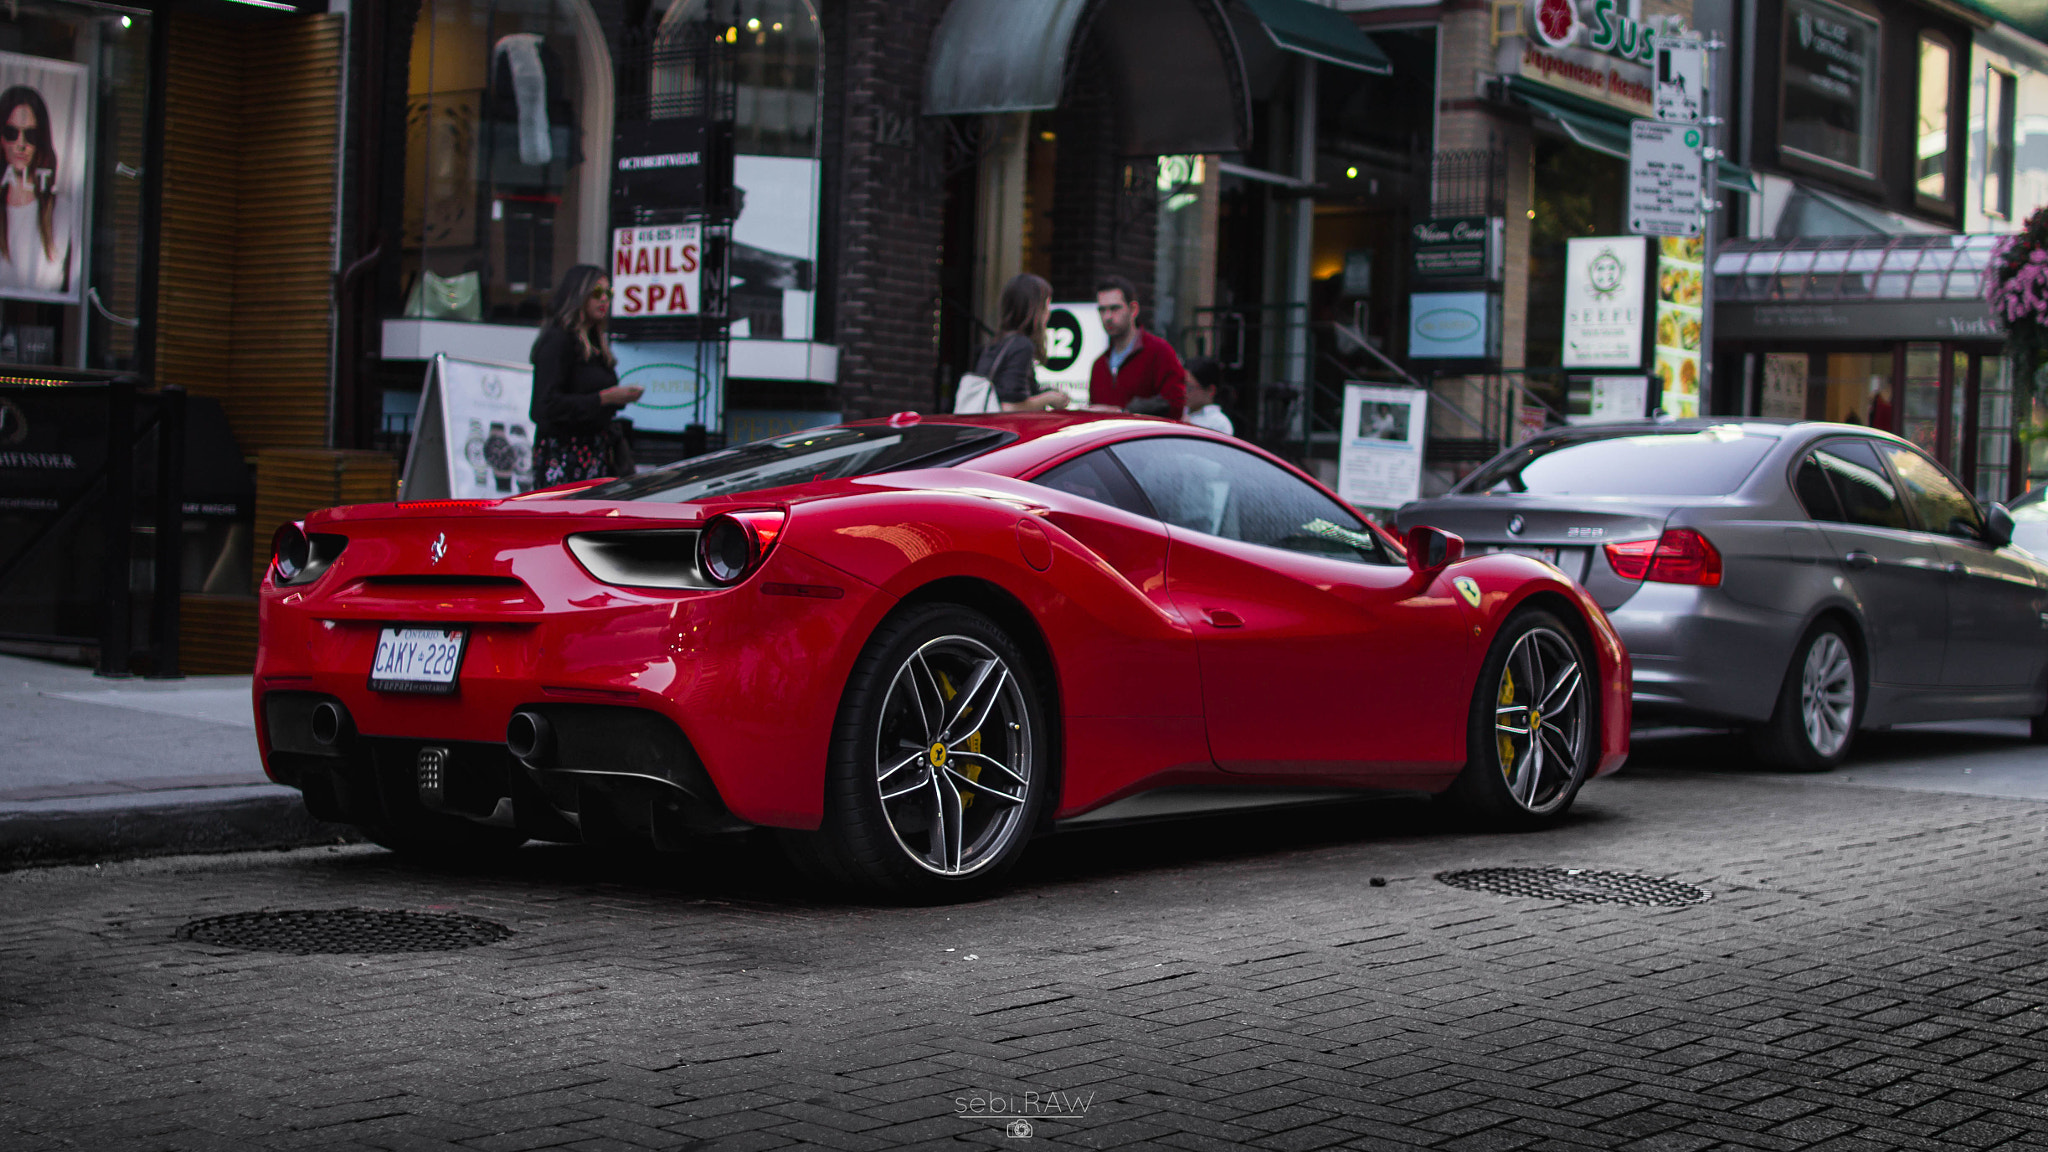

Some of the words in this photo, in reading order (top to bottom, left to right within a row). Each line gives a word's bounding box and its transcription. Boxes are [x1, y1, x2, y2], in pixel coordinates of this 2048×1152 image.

[1523, 42, 1604, 88] Japanese
[616, 245, 698, 276] NAILS
[623, 284, 688, 313] SPA
[404, 630, 439, 640] ONTARIO
[375, 642, 417, 673] CAKY
[423, 644, 457, 675] 228
